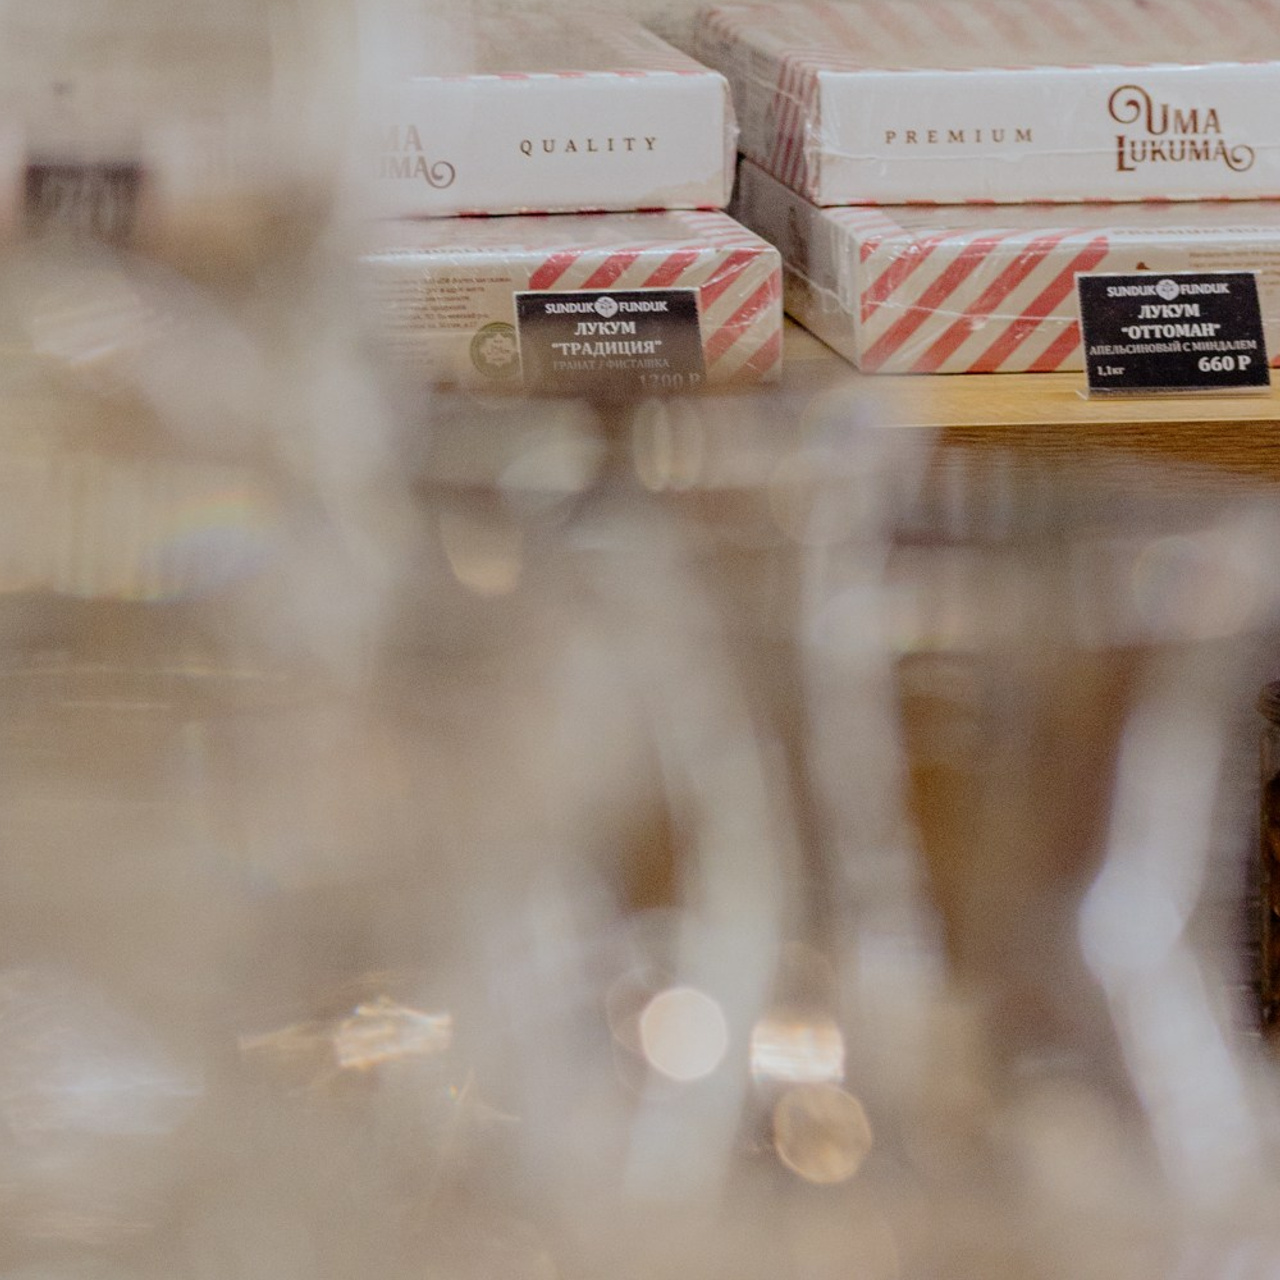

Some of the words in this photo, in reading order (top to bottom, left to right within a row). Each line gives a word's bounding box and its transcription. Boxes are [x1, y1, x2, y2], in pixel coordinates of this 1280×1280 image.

[885, 128, 1034, 145] PREMIUM
[520, 137, 658, 157] QUALITY
[1116, 135, 1256, 173] LUKUMA
[1107, 285, 1157, 297] SUNDUK
[1179, 283, 1231, 295] FUNDUK
[544, 301, 594, 314] SUNDUK
[618, 300, 668, 313] FUNDUK
[1138, 303, 1201, 319] ЛУКУМ
[574, 321, 636, 336] ЛУКУМ
[1089, 340, 1181, 356] АПЕЛЬСИНОВЫЙ
[1192, 340, 1257, 351] МИНДАЛЕМ
[605, 359, 670, 370] ФИСТАШКА
[1198, 356, 1235, 372] 660
